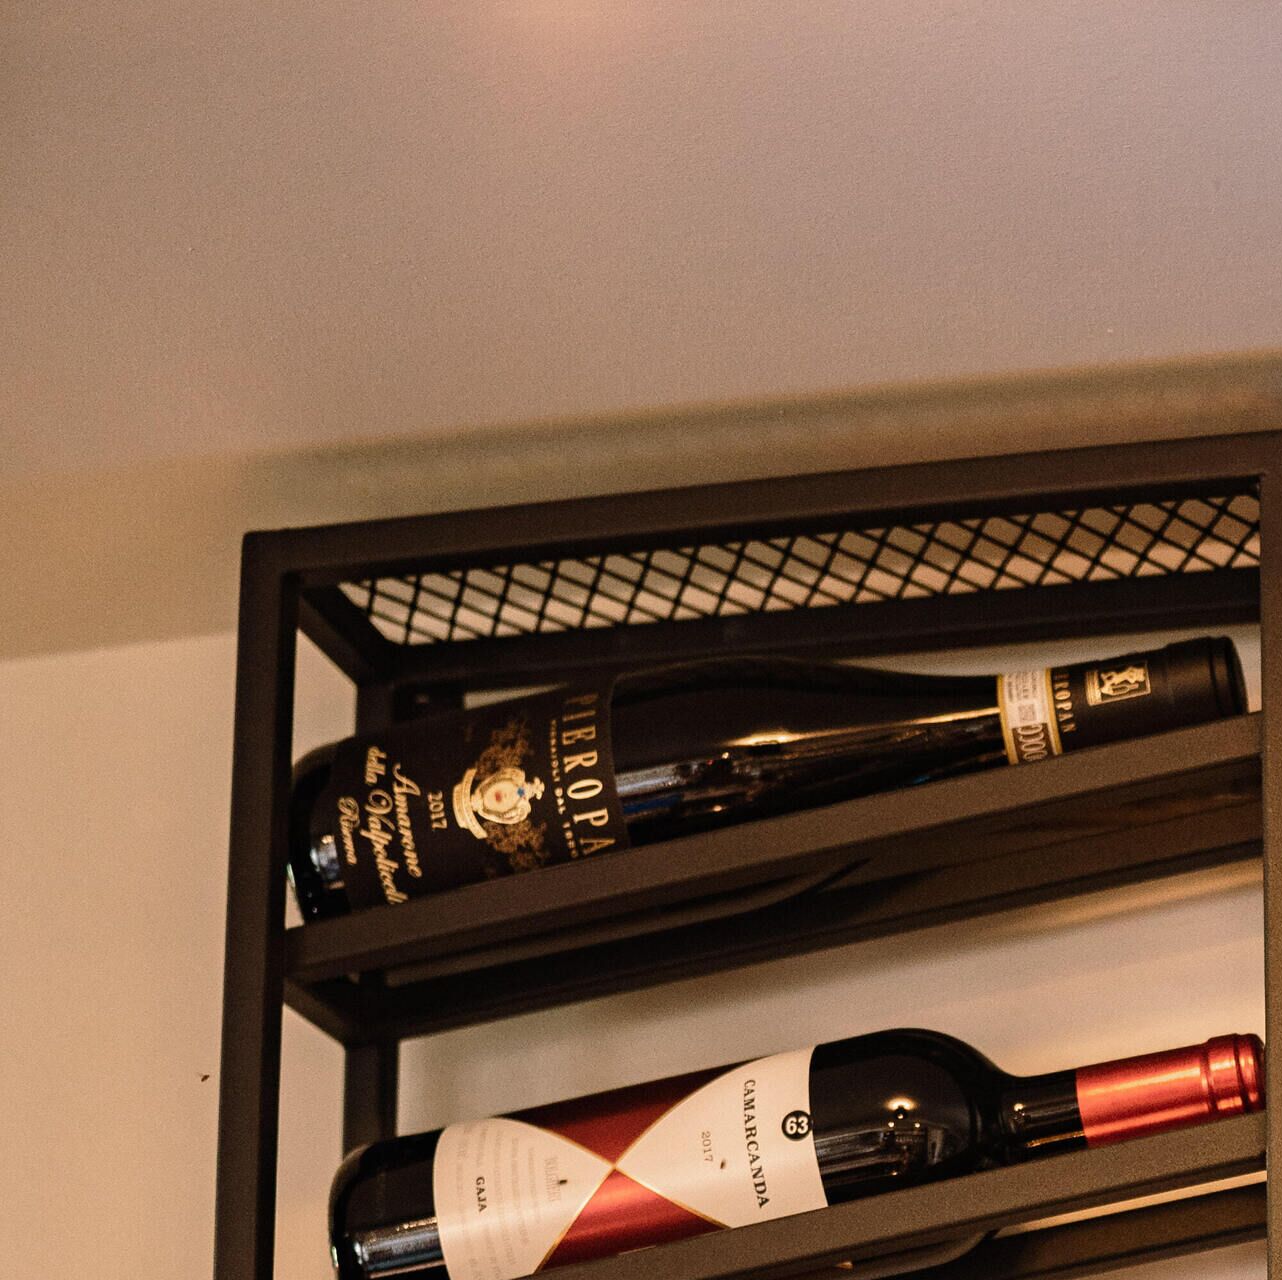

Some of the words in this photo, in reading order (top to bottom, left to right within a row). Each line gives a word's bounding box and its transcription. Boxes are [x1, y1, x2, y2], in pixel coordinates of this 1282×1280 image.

[427, 791, 449, 831] 2017
[554, 787, 567, 816] DAL
[392, 763, 423, 879] Amarone
[743, 1078, 770, 1209] CAMARCANDA
[785, 1116, 810, 1137] 63
[701, 1130, 714, 1163] 2017
[475, 1176, 488, 1213] GAJA
